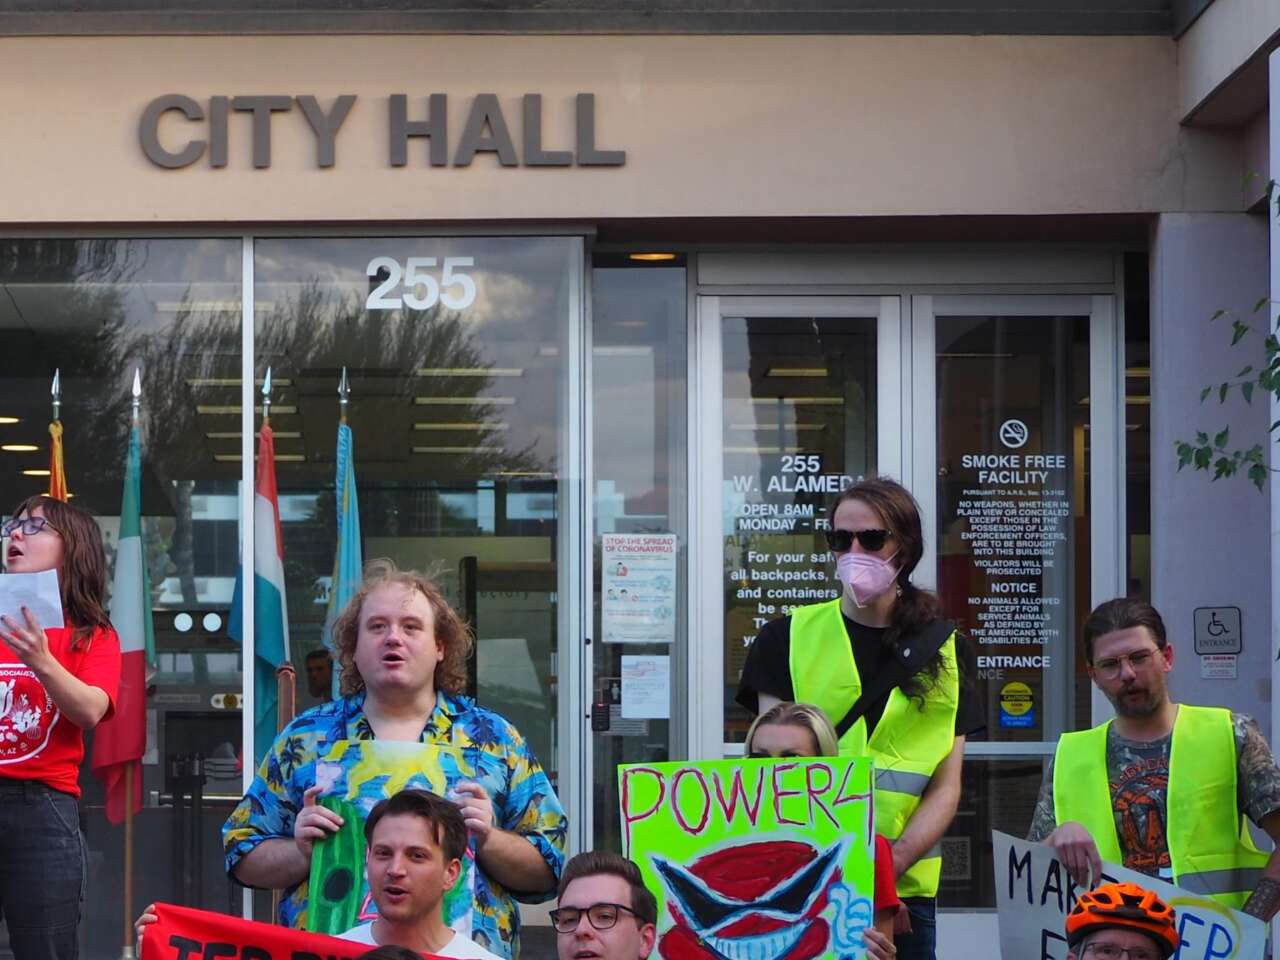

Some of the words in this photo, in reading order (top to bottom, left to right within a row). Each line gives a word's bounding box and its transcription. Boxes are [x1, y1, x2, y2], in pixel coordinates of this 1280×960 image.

[138, 93, 358, 170] CITY
[389, 92, 626, 168] HALL
[366, 256, 476, 311] 255
[781, 455, 820, 473] 255
[962, 455, 1020, 468] SMOKE
[1024, 455, 1066, 468] FREE
[978, 470, 1048, 484] FACILITY
[733, 475, 758, 492] W.
[767, 475, 865, 492] ALAMED
[959, 500, 972, 508] NO
[973, 500, 1017, 509] WEAPONS,
[1018, 500, 1059, 508] WHETHER
[1060, 500, 1069, 508] IN
[741, 503, 779, 516] OPEN
[783, 503, 814, 516] 8AM
[957, 508, 981, 516] PLAIN
[982, 508, 1003, 516] VIEW
[1004, 508, 1018, 516] OR
[1018, 508, 1069, 516] CONCEALED
[740, 518, 796, 531] MONDAY
[815, 519, 832, 531] FR
[969, 516, 1001, 524] EXCEPT
[1002, 516, 1031, 524] THOSE
[1032, 516, 1040, 524] IN
[1042, 516, 1059, 524] THE
[971, 524, 1024, 532] POSSESSION
[1025, 524, 1037, 532] OF
[1039, 524, 1057, 532] LAW
[961, 532, 1023, 540] ENFORCEMENT
[605, 537, 625, 546] STOP
[626, 537, 643, 546] THE
[643, 537, 673, 546] SPREAD
[972, 540, 989, 548] ARE
[990, 540, 1002, 548] TO
[1003, 540, 1015, 548] BE
[1016, 540, 1057, 548] BROUGHT
[605, 545, 616, 553] OF
[616, 545, 674, 553] CORONAVIRUS
[974, 548, 993, 556] INTO
[995, 548, 1014, 556] THIS
[1015, 548, 1054, 556] BUILDING
[748, 551, 770, 563] For
[776, 553, 804, 565] your
[810, 551, 834, 563] saf
[974, 560, 1021, 568] VIOLATORS
[1022, 560, 1041, 568] WILL
[1042, 560, 1054, 568] BE
[731, 568, 747, 580] all
[751, 568, 829, 583] backpacks,
[986, 567, 1042, 576] PROSECUTED
[991, 582, 1037, 593] NOTICE
[736, 587, 762, 599] and
[767, 587, 839, 599] containers
[968, 597, 981, 605] NO
[982, 597, 1019, 605] ANIMALS
[1020, 597, 1060, 605] ALLOWED
[758, 602, 776, 614] be
[988, 605, 1020, 613] EXCEPT
[1021, 605, 1040, 613] FOR
[977, 613, 1013, 621] SERVICE
[1014, 613, 1051, 621] ANIMALS
[983, 621, 996, 629] AS
[996, 621, 1032, 629] DEFINED
[1033, 621, 1045, 629] BY
[970, 629, 987, 637] THE
[987, 629, 1037, 637] AMERICANS
[1038, 629, 1059, 637] WITH
[979, 637, 1031, 645] DISABILITIES
[1032, 637, 1049, 645] ACT
[1199, 638, 1237, 648] ENTRANCE
[977, 655, 1051, 668] ENTRANCE
